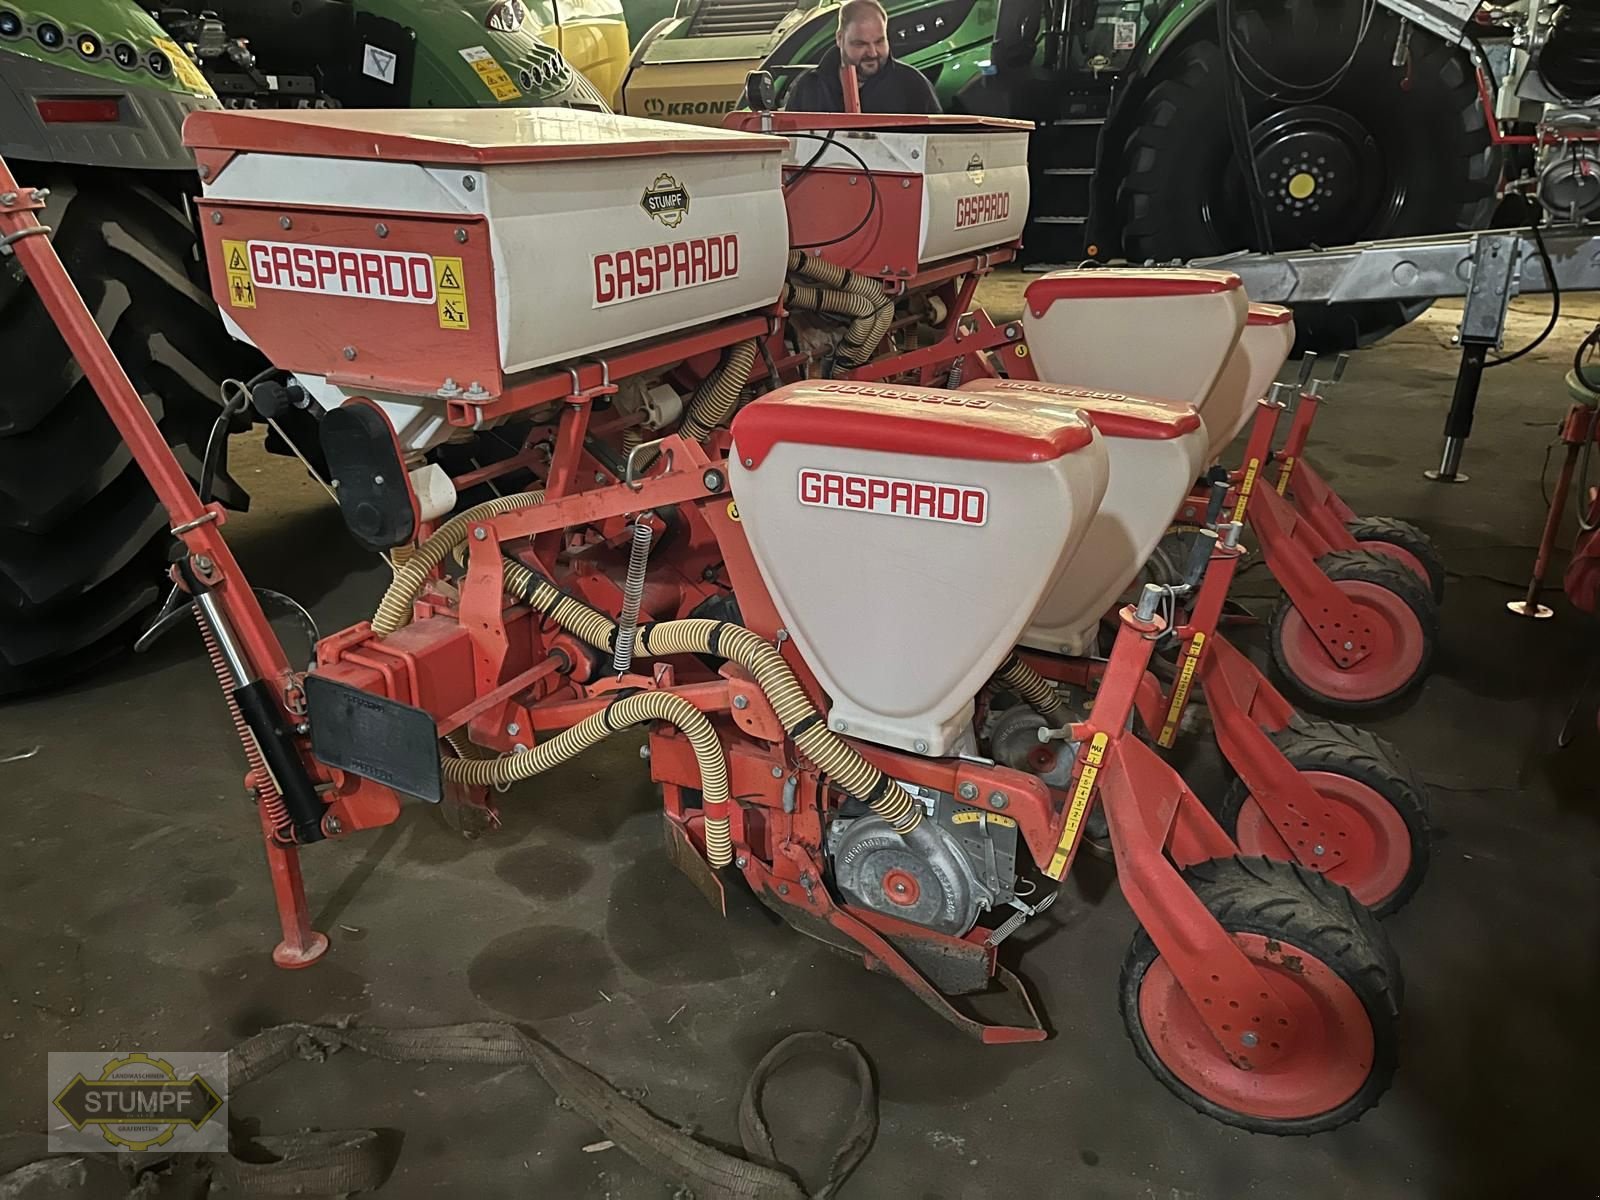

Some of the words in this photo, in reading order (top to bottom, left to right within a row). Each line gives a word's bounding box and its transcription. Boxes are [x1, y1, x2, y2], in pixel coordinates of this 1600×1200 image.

[667, 100, 737, 116] KRONE
[648, 193, 682, 210] STUMPF
[956, 192, 1009, 227] GASPARDO
[250, 244, 433, 299] GASPARDO
[594, 234, 738, 303] GASPARDO
[801, 471, 985, 524] GASPARDO
[1091, 744, 1103, 752] MAX
